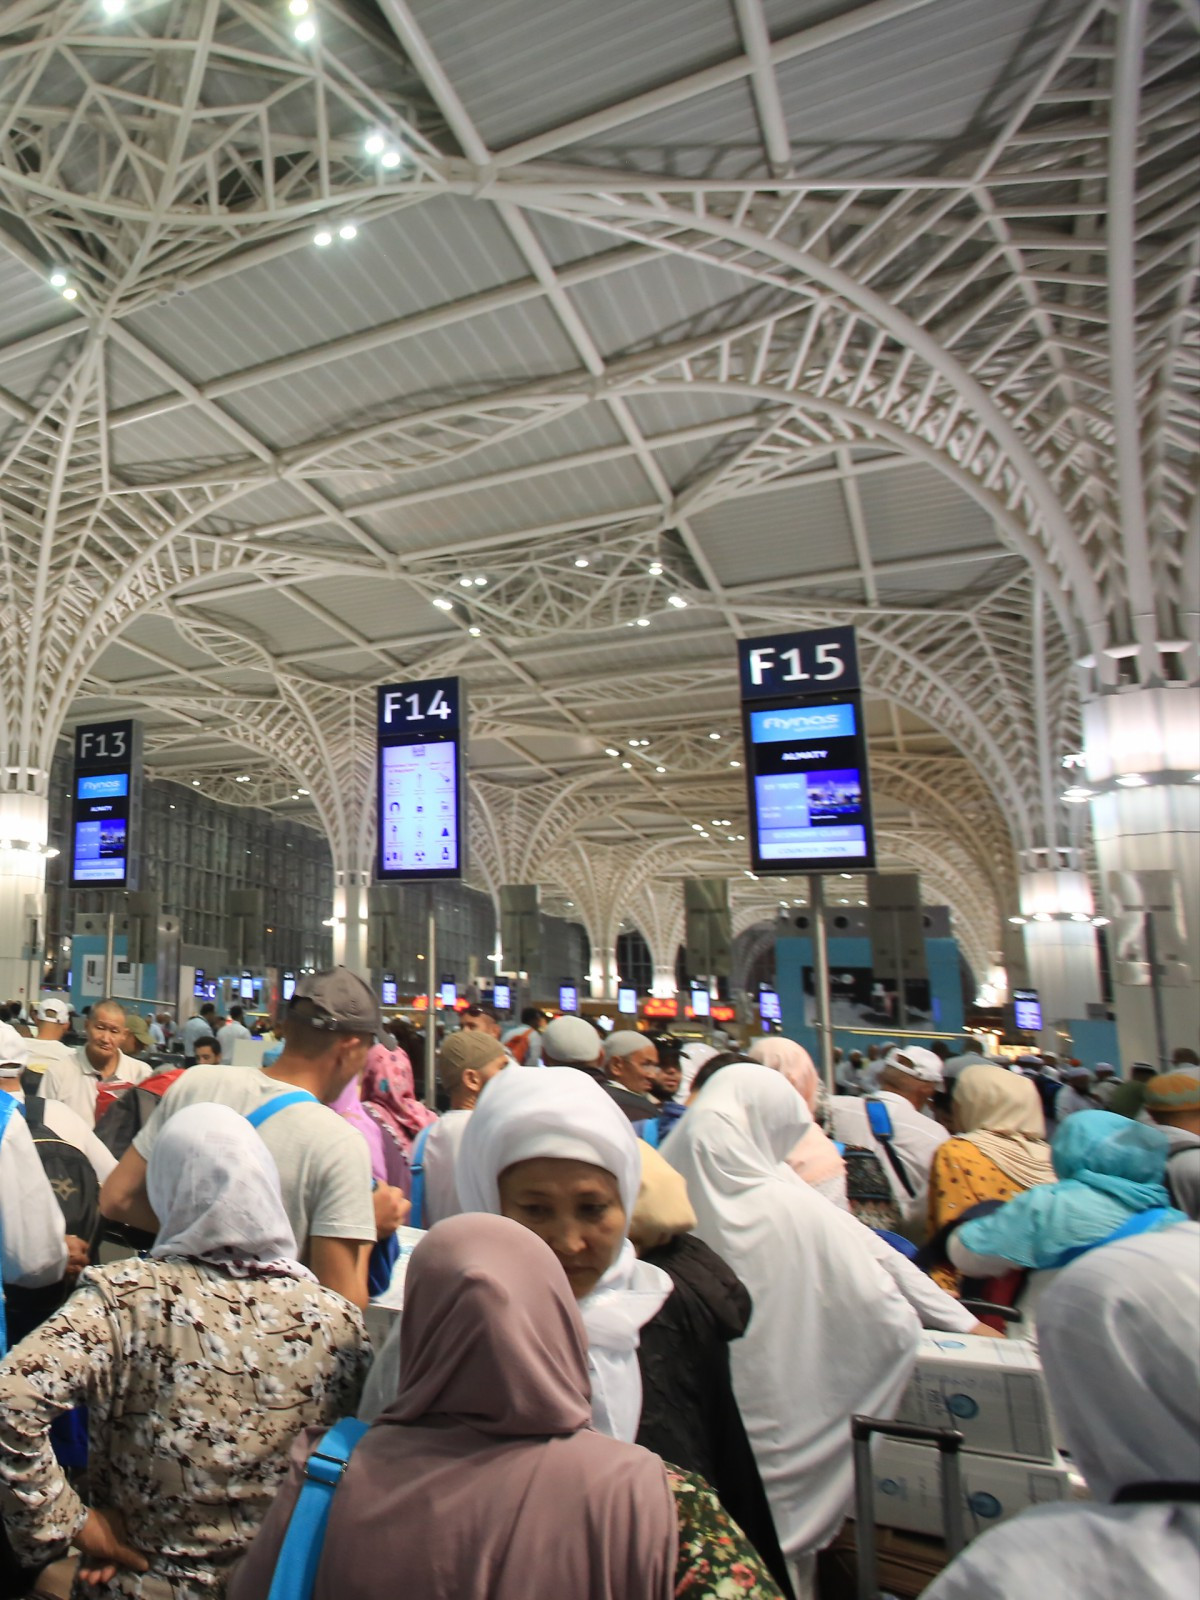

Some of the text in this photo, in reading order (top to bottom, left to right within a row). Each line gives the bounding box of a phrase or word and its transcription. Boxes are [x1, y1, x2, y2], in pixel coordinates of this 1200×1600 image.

[749, 643, 845, 685] F15
[384, 690, 452, 723] F14
[80, 731, 126, 758] F13
